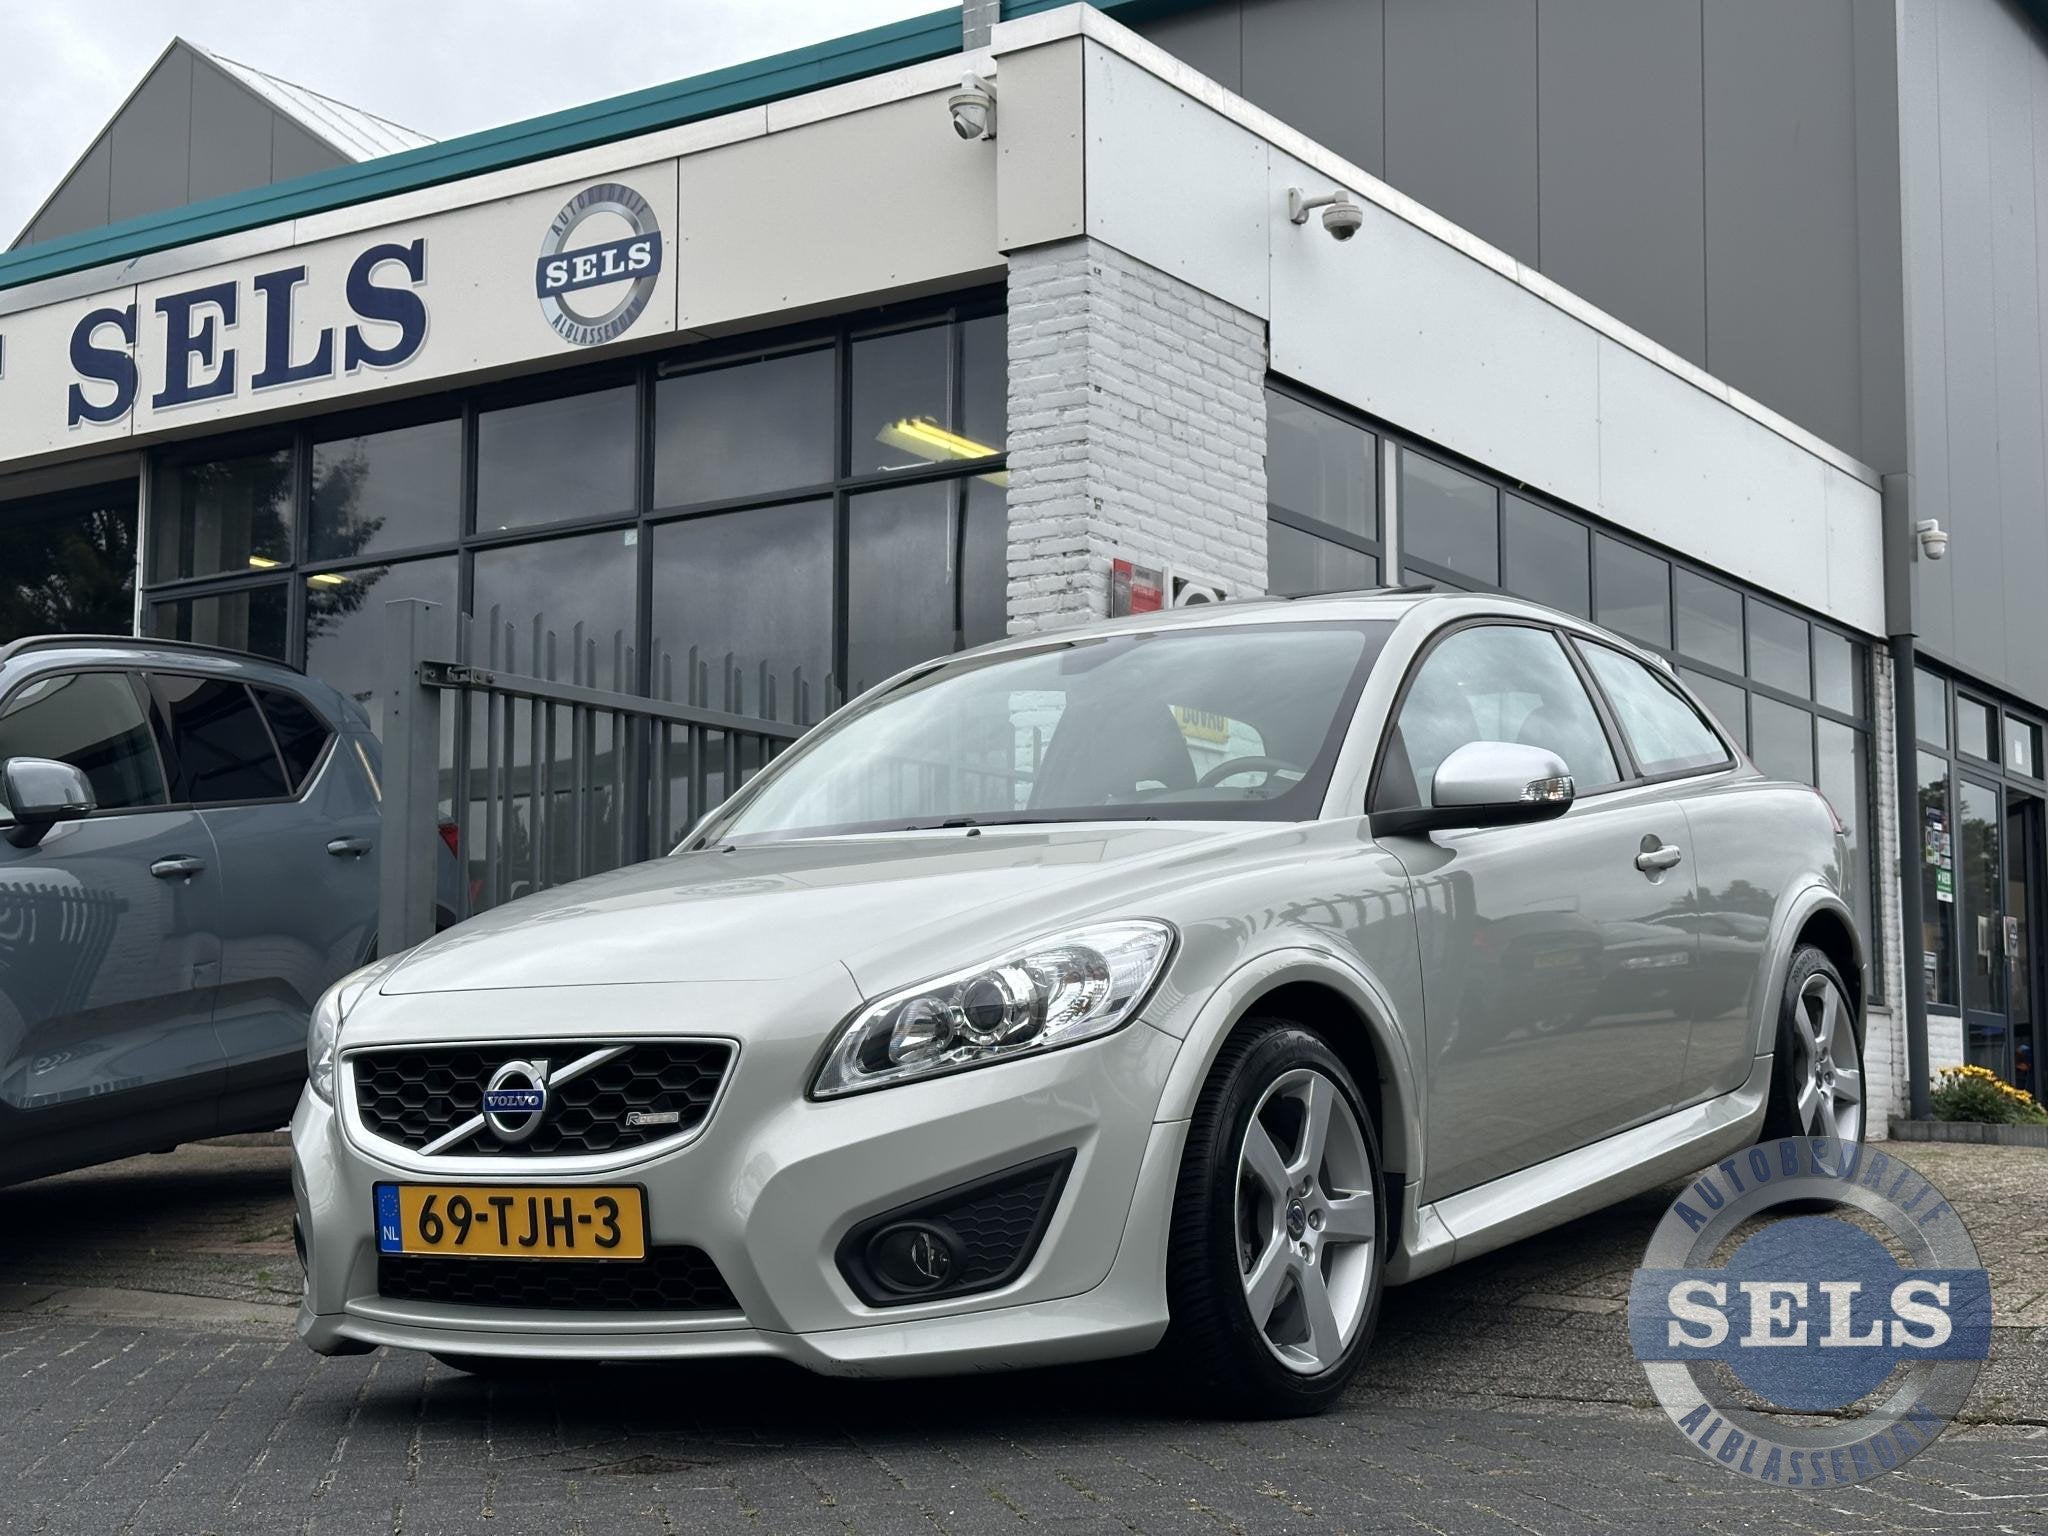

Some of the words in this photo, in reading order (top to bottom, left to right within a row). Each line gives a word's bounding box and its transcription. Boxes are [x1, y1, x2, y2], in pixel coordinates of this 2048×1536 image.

[546, 242, 651, 288] SELS
[68, 238, 428, 430] SELS
[488, 1095, 540, 1107] VOLVO
[383, 1226, 400, 1241] NL
[418, 1194, 622, 1249] 69-TJH-3
